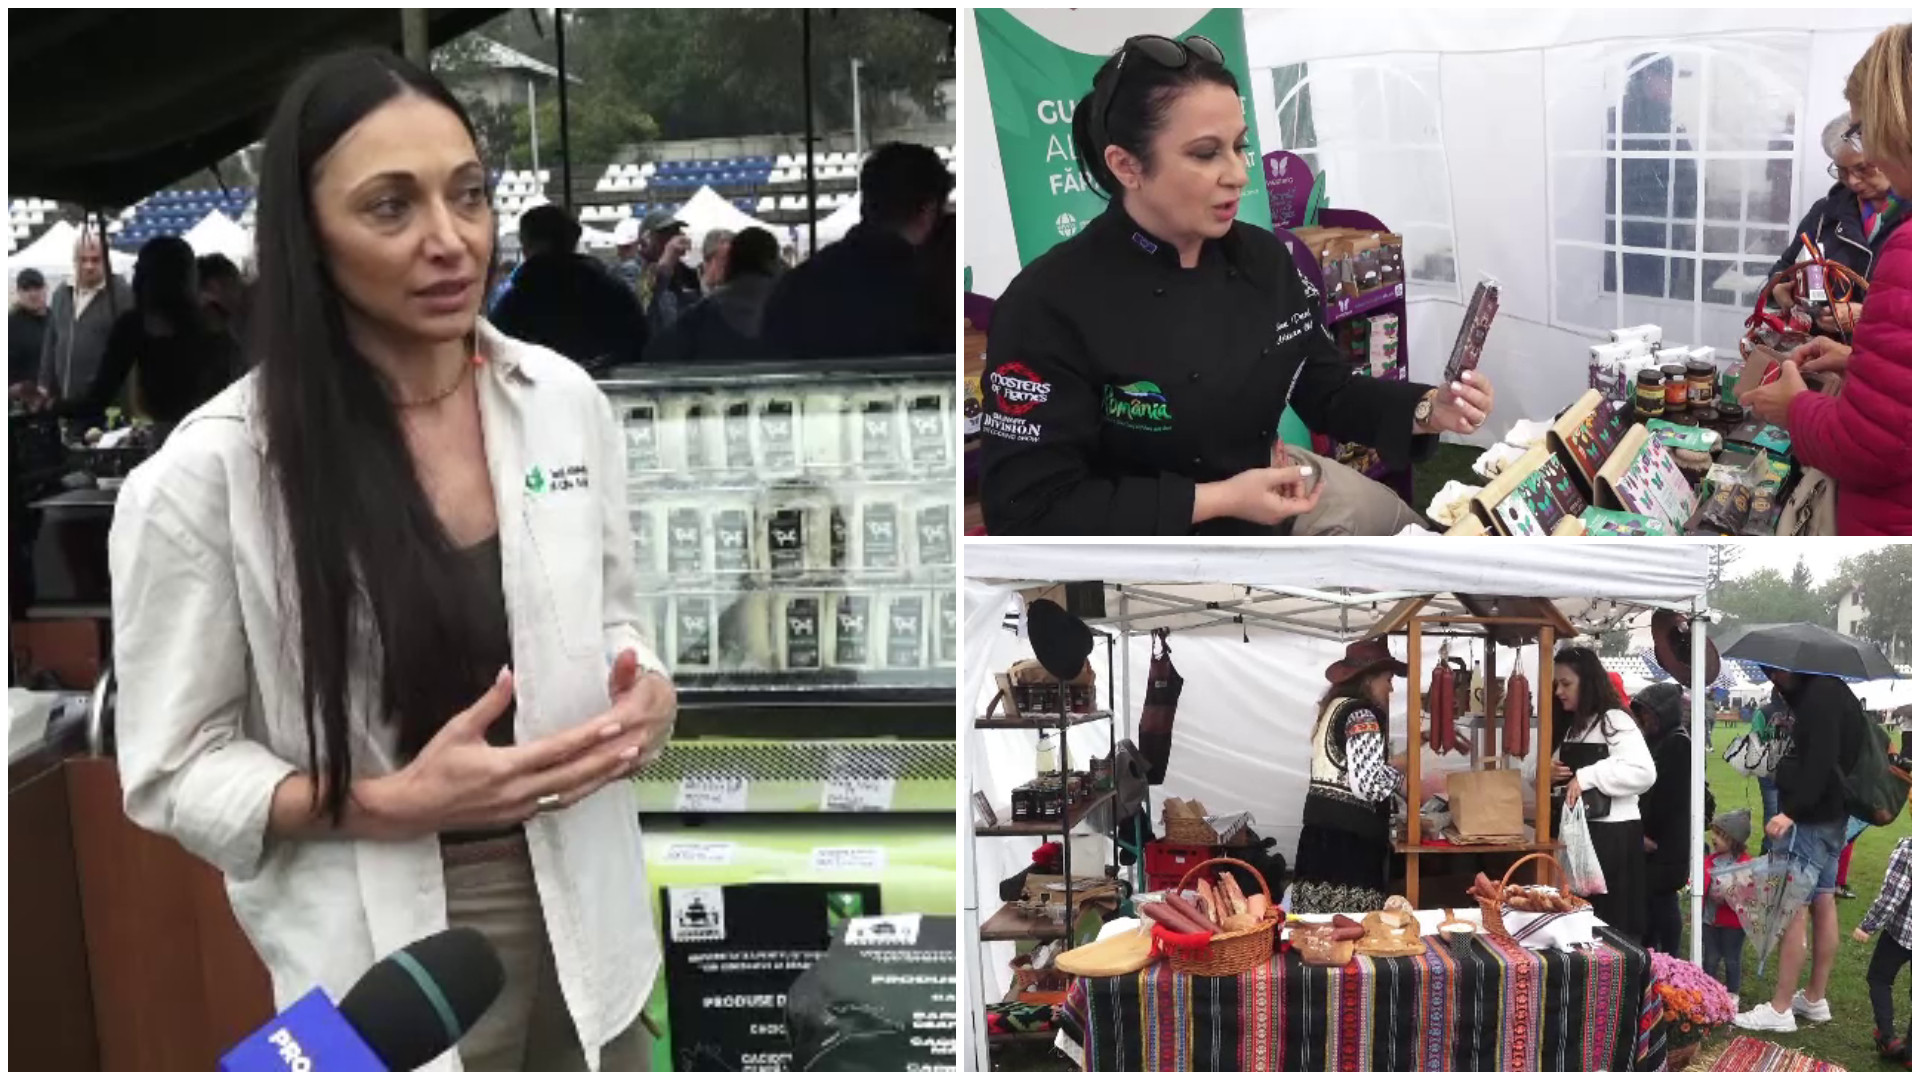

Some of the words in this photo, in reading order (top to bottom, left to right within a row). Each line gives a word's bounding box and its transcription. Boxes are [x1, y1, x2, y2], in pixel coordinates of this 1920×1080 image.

[1037, 99, 1079, 125] GU
[1049, 167, 1100, 195] FĂR
[984, 413, 1042, 437] DIVISION
[702, 994, 776, 1008] PRODUSE
[268, 1027, 312, 1072] PRO
